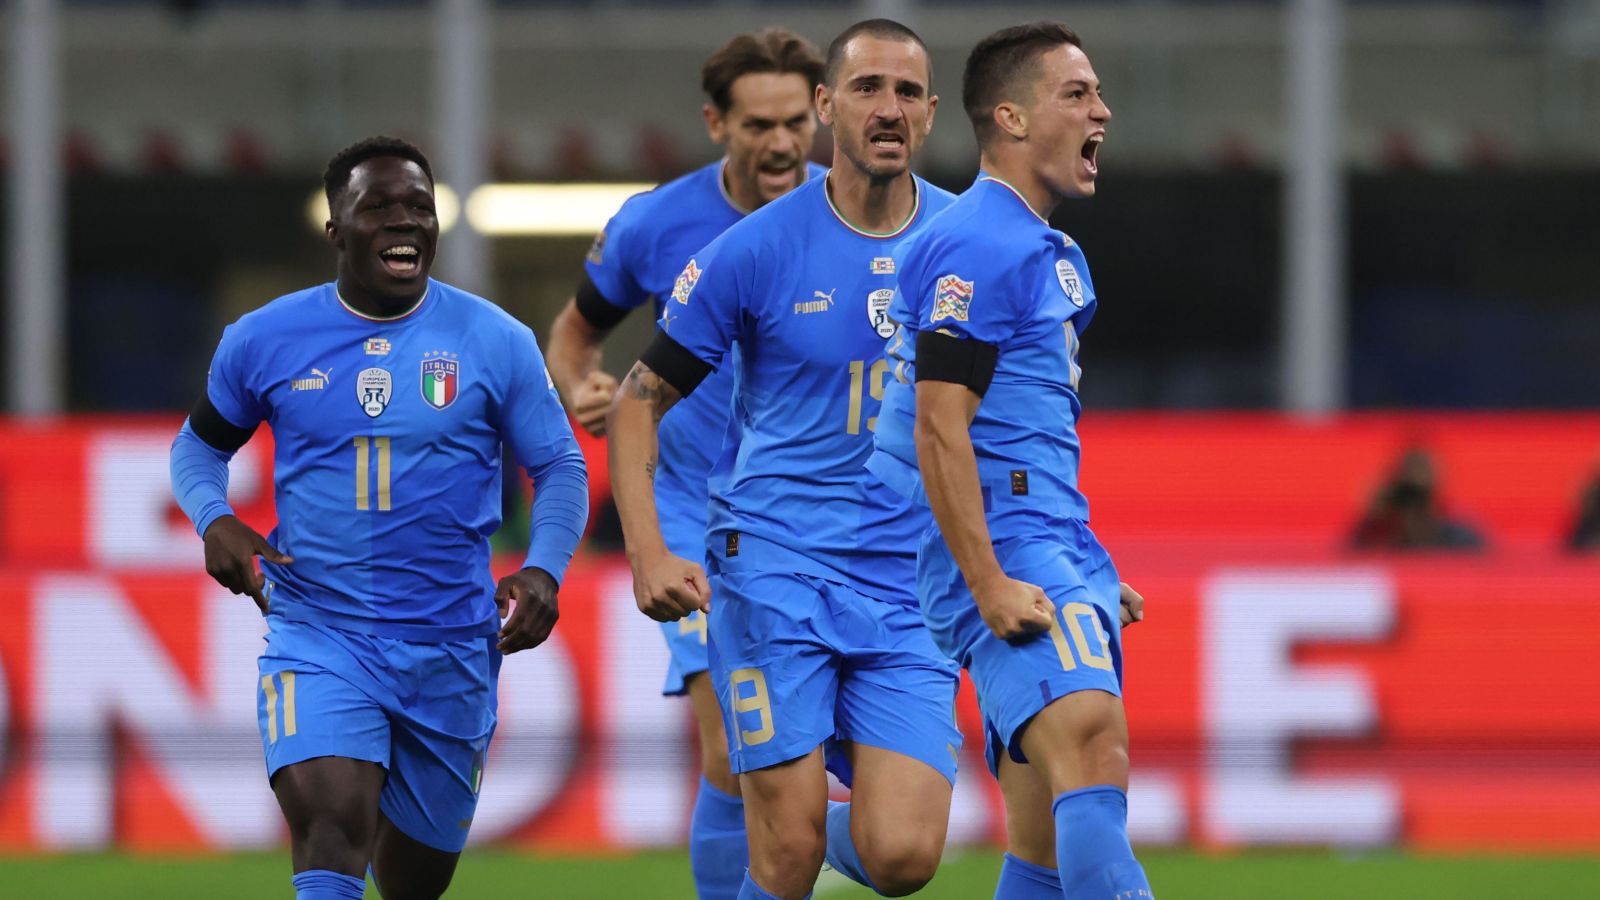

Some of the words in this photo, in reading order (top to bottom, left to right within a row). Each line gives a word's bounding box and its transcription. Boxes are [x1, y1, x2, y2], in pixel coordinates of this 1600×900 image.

[794, 300, 828, 315] PUMA
[291, 378, 324, 391] PUMA
[424, 361, 456, 371] ITALIA
[353, 436, 391, 511] 11
[1048, 602, 1113, 672] 10
[261, 671, 297, 745] 11
